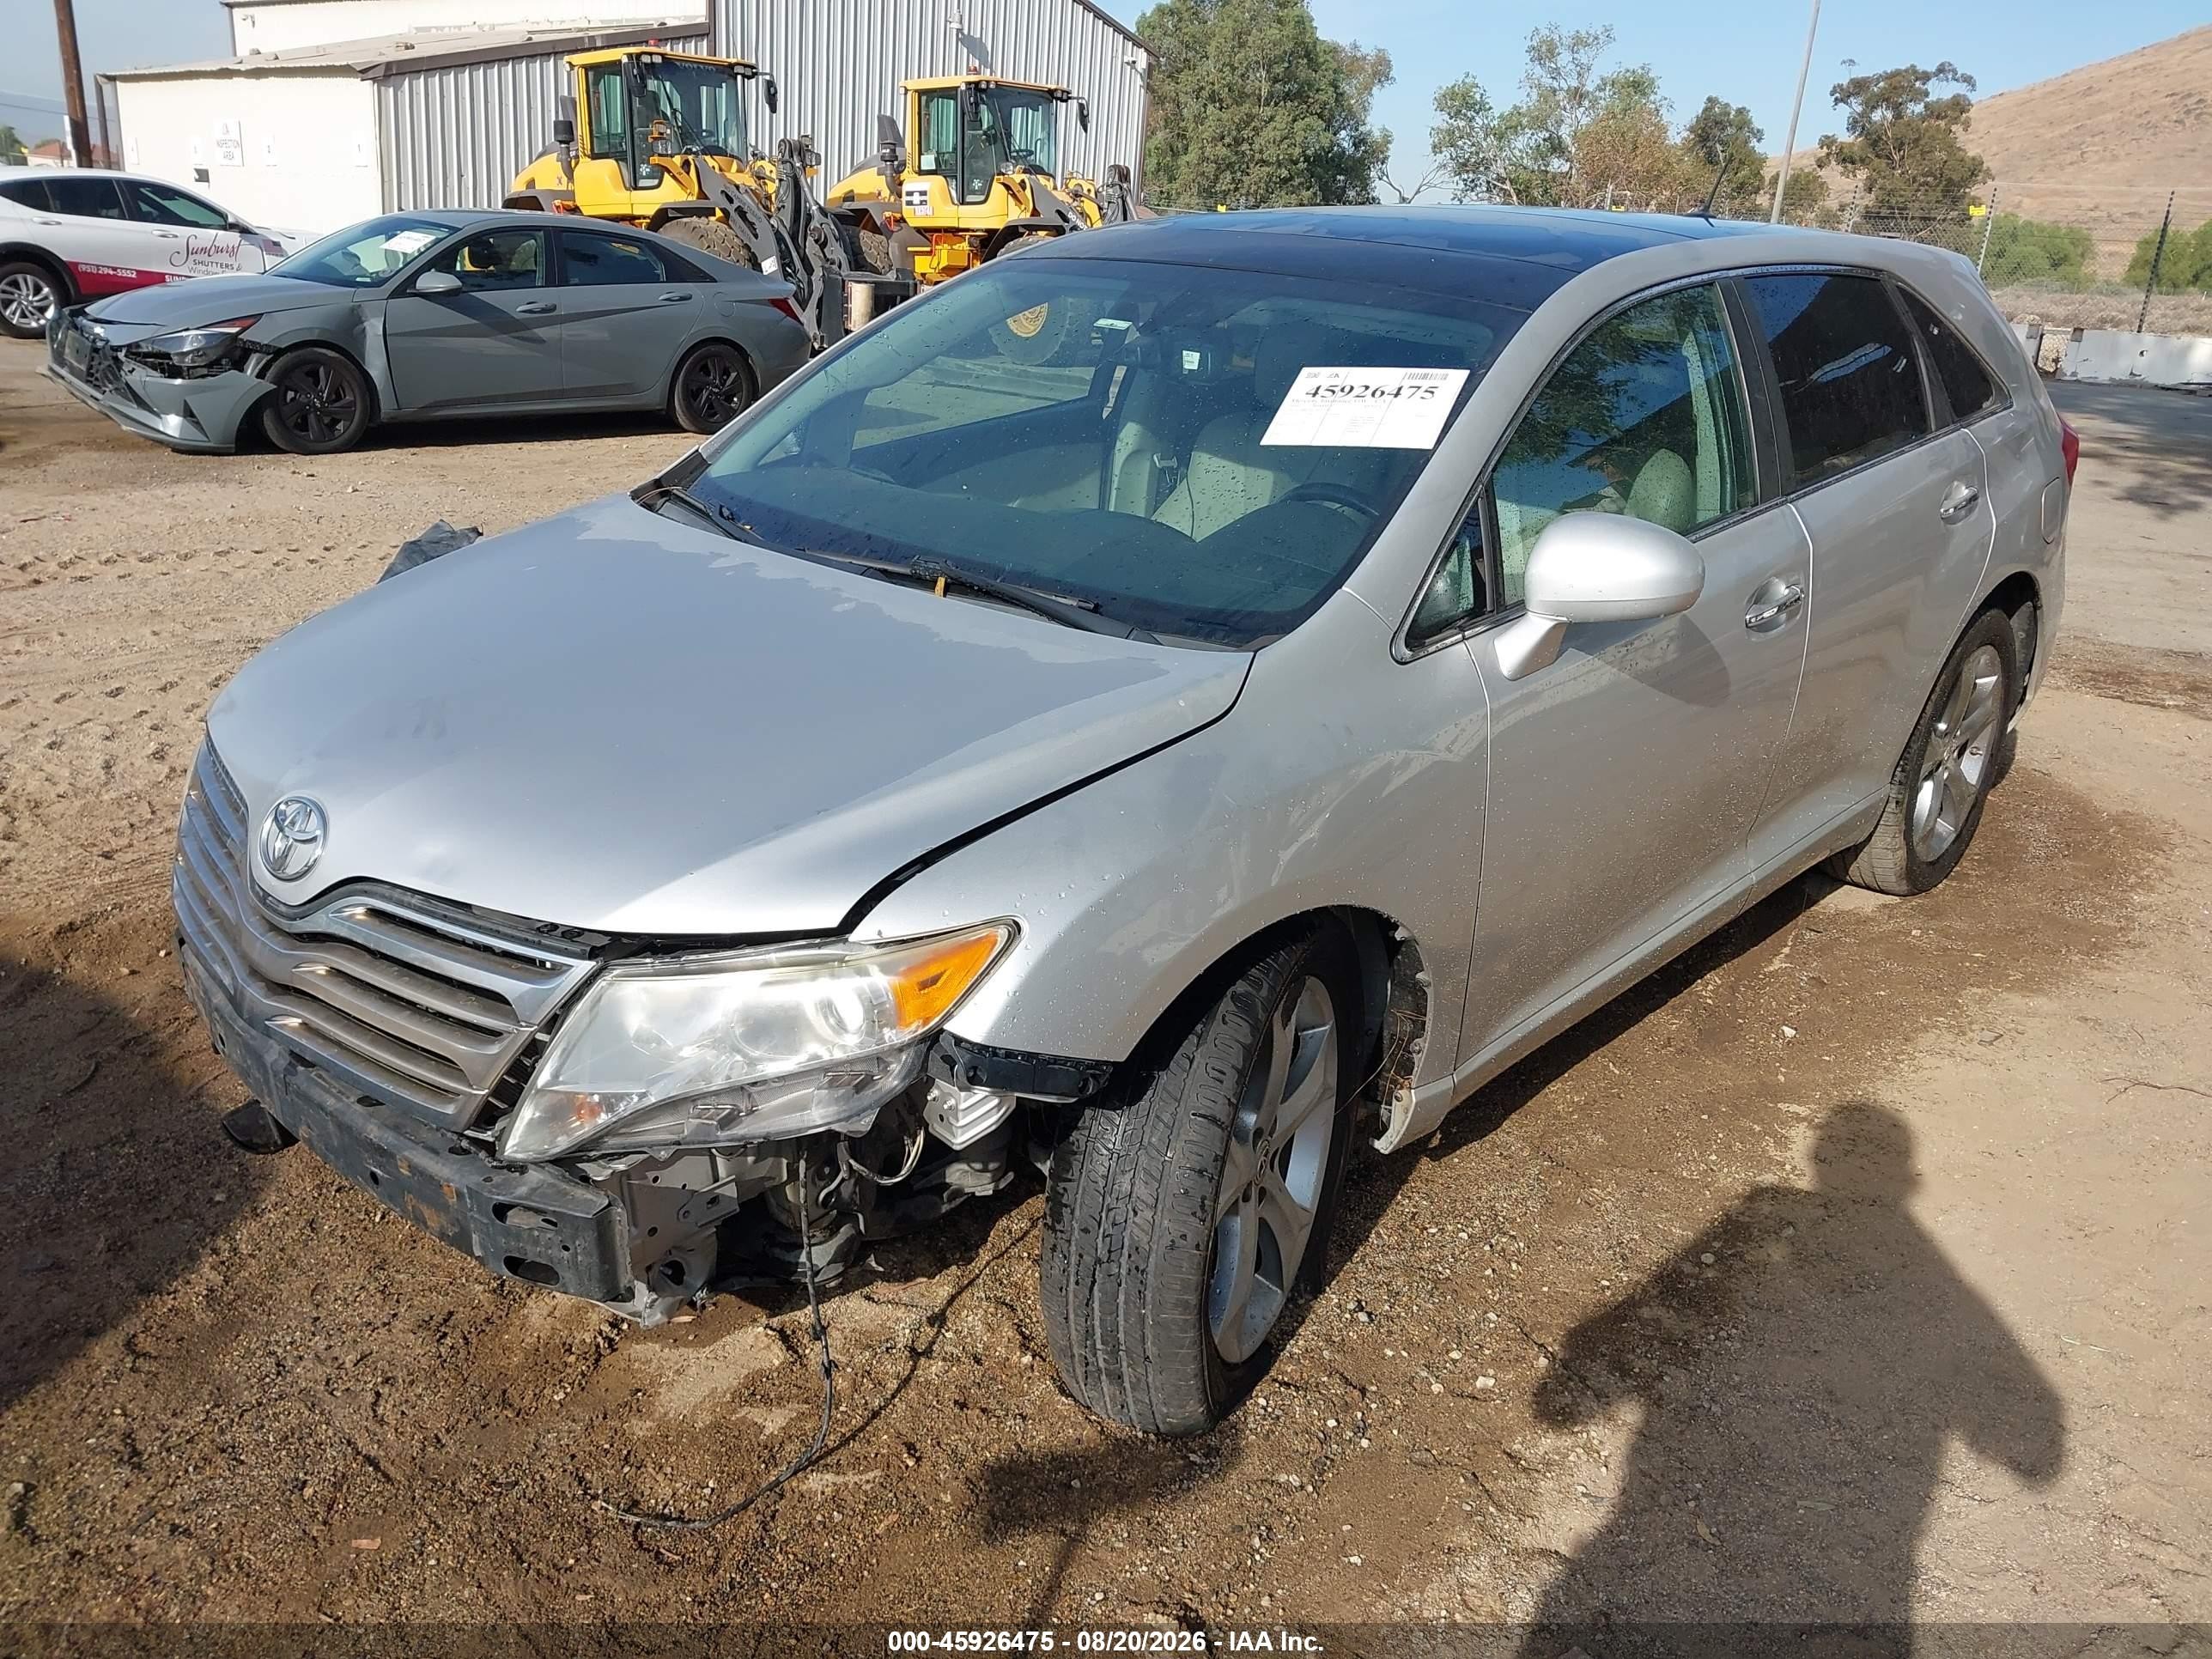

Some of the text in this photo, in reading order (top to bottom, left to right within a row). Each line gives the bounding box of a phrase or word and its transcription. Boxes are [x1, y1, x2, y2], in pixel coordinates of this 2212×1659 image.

[1067, 211, 1077, 222] DO
[169, 232, 242, 267] Sunburst
[193, 258, 234, 270] SHUTTERS
[98, 266, 137, 279] 294-5552
[1305, 385, 1439, 399] 45926475
